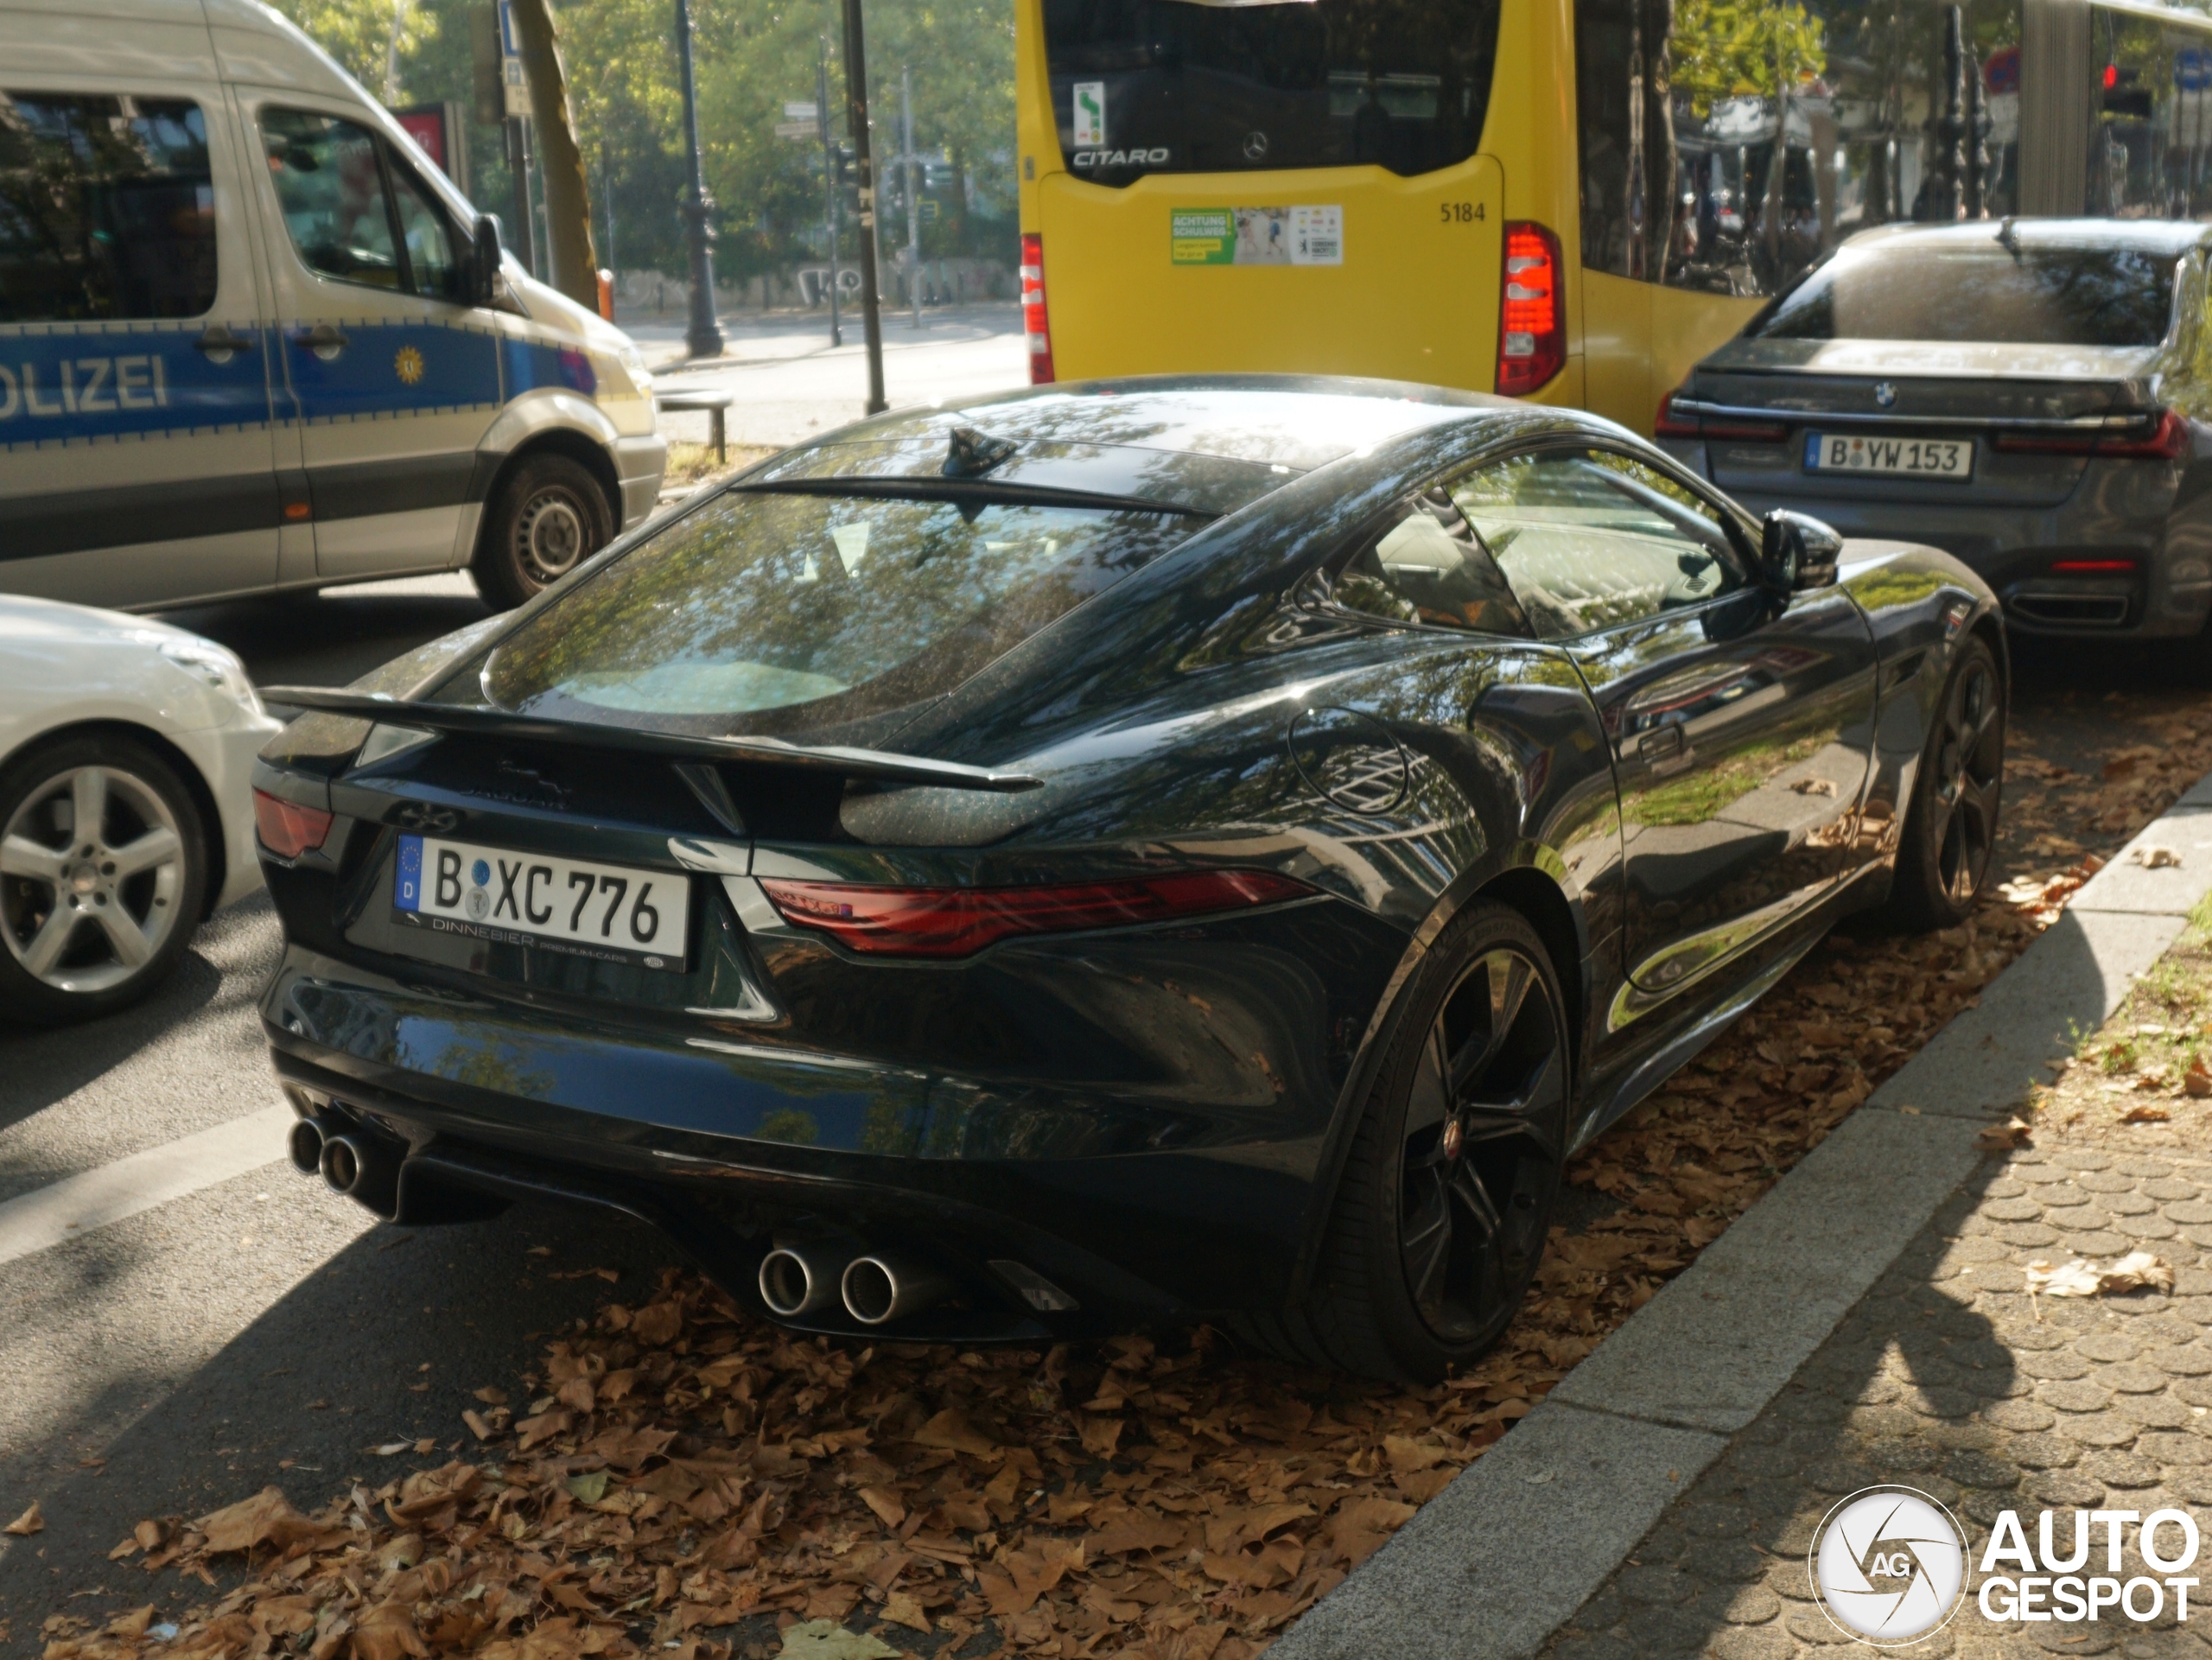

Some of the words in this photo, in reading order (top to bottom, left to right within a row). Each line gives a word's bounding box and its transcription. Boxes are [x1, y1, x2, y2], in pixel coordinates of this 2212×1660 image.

[1073, 148, 1168, 166] CITARO
[1173, 216, 1226, 226] ACHTUNG
[1440, 202, 1485, 222] 5184
[1830, 439, 1847, 466] B
[1867, 441, 1902, 468] YW
[1906, 442, 1960, 472] 153
[403, 881, 414, 900] D
[434, 849, 462, 908] B
[493, 859, 553, 925] XC
[568, 871, 659, 944] 776
[432, 919, 535, 948] DINNEBIER
